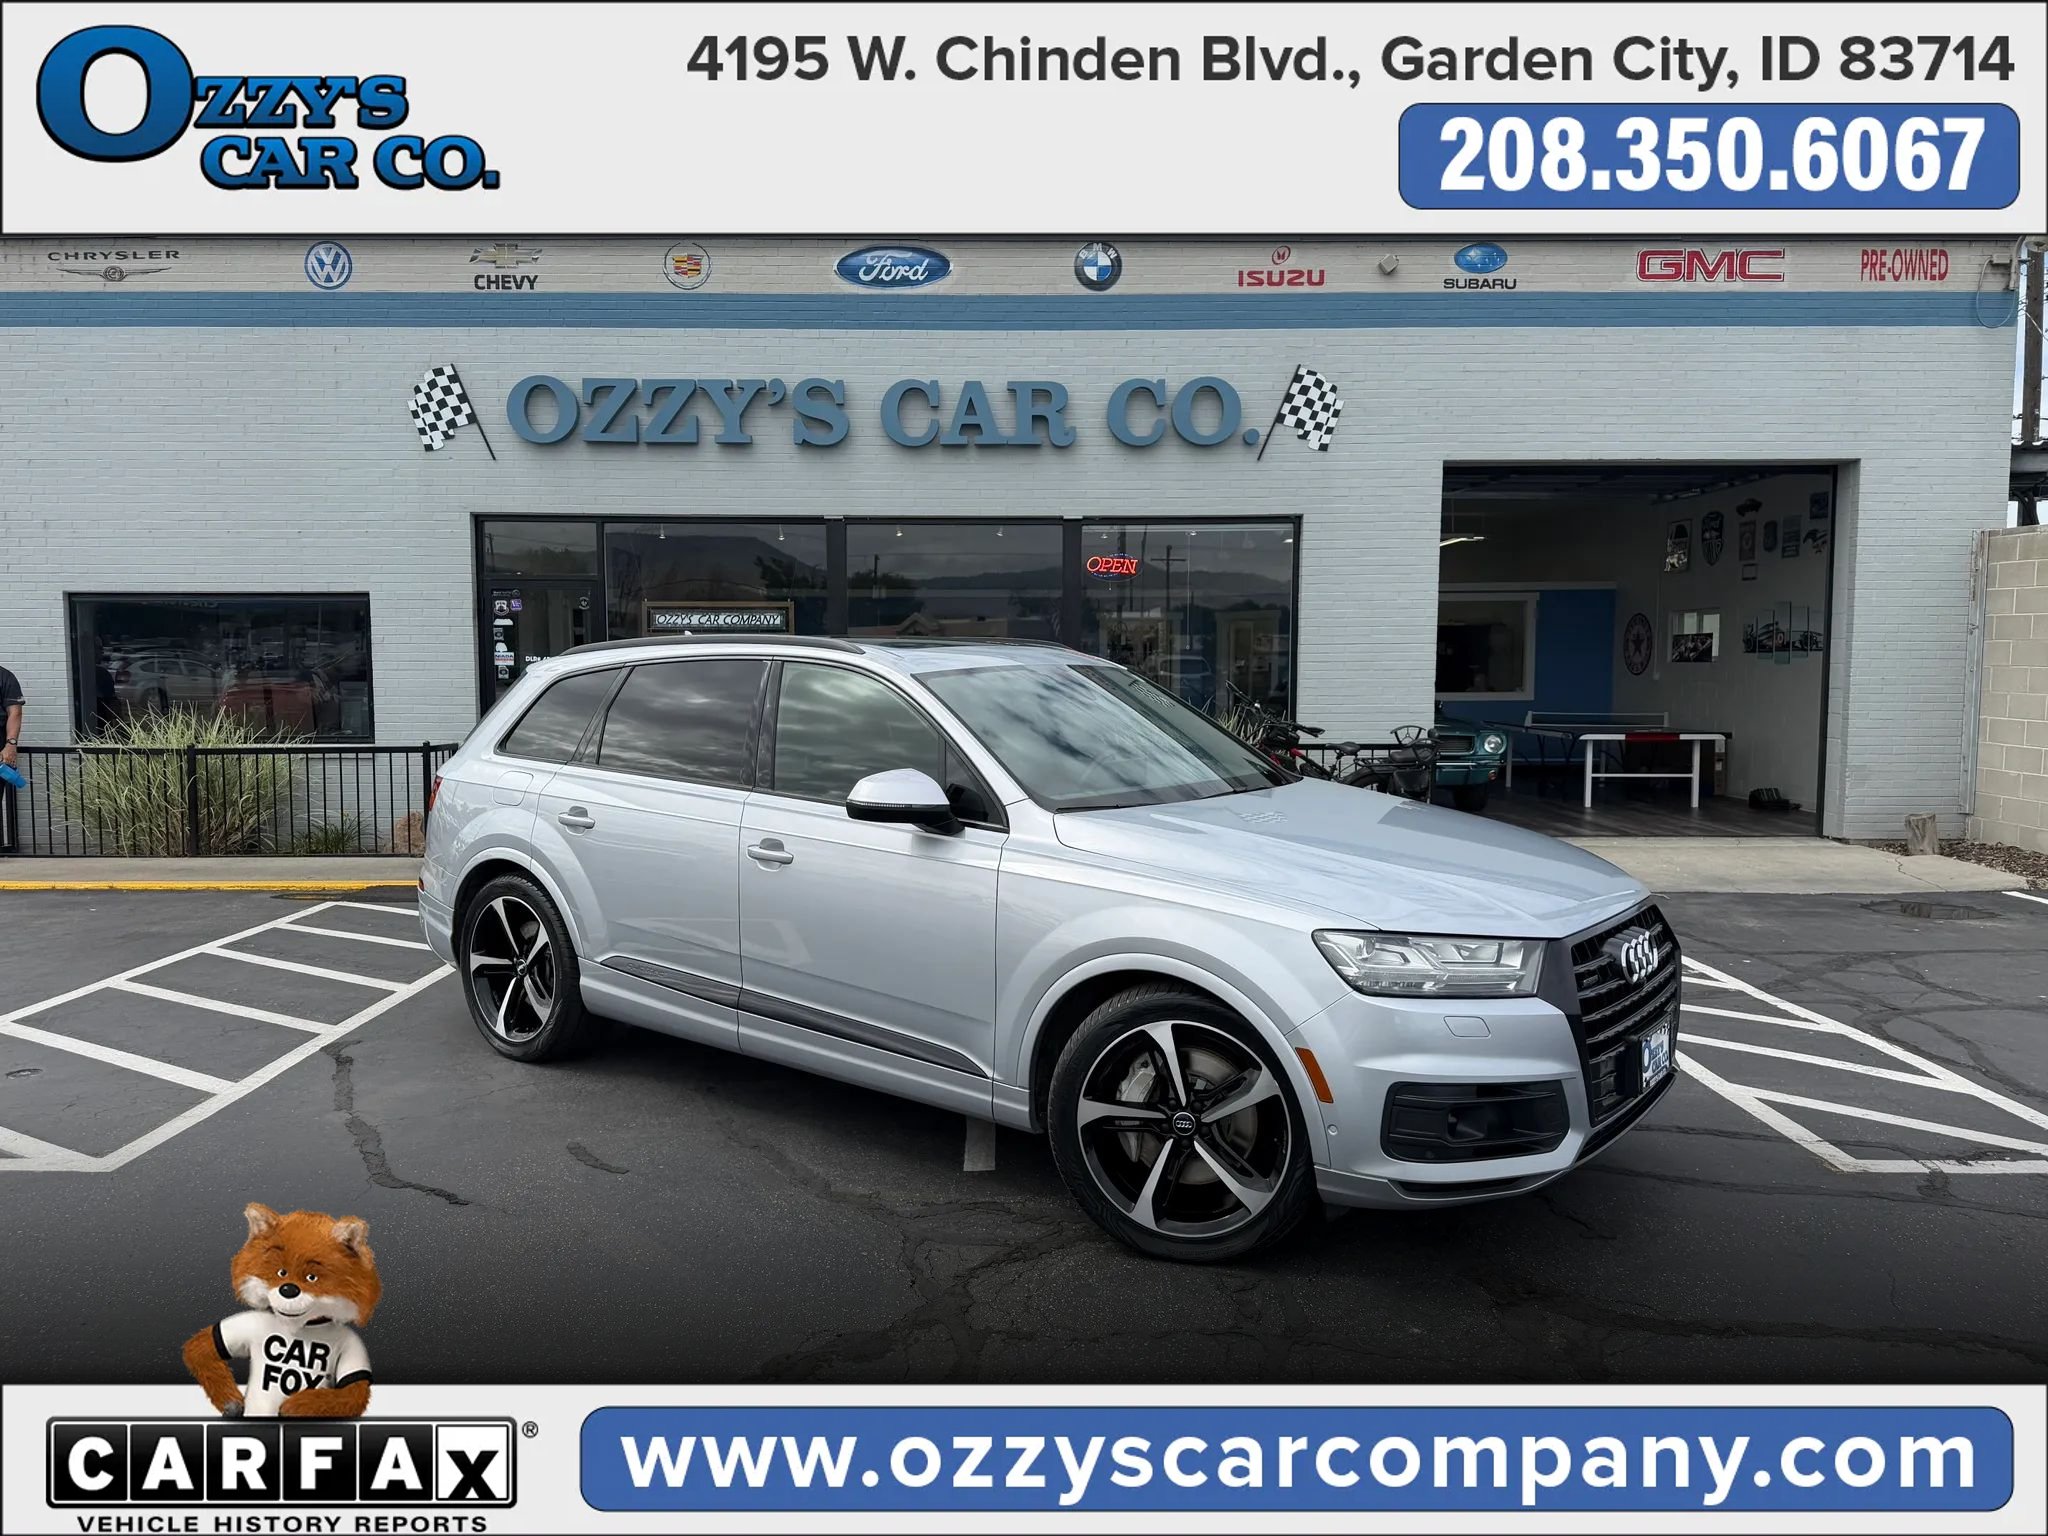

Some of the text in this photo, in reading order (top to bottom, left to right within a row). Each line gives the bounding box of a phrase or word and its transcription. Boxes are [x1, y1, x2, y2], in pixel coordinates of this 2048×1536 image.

[47, 249, 180, 261] CHRYSLER
[1079, 242, 1117, 260] BMW
[858, 250, 929, 281] Ford
[1637, 250, 1784, 281] GMC
[1860, 249, 1949, 281] PRE-OWNED
[473, 274, 538, 290] CHEVY
[1238, 269, 1325, 287] ISUZU
[1443, 278, 1517, 290] SUBARU
[506, 375, 1261, 447] OZZY'S CAR CO.
[1086, 556, 1138, 575] OPEN
[657, 613, 780, 625] OZZY'S CAR COMPANY
